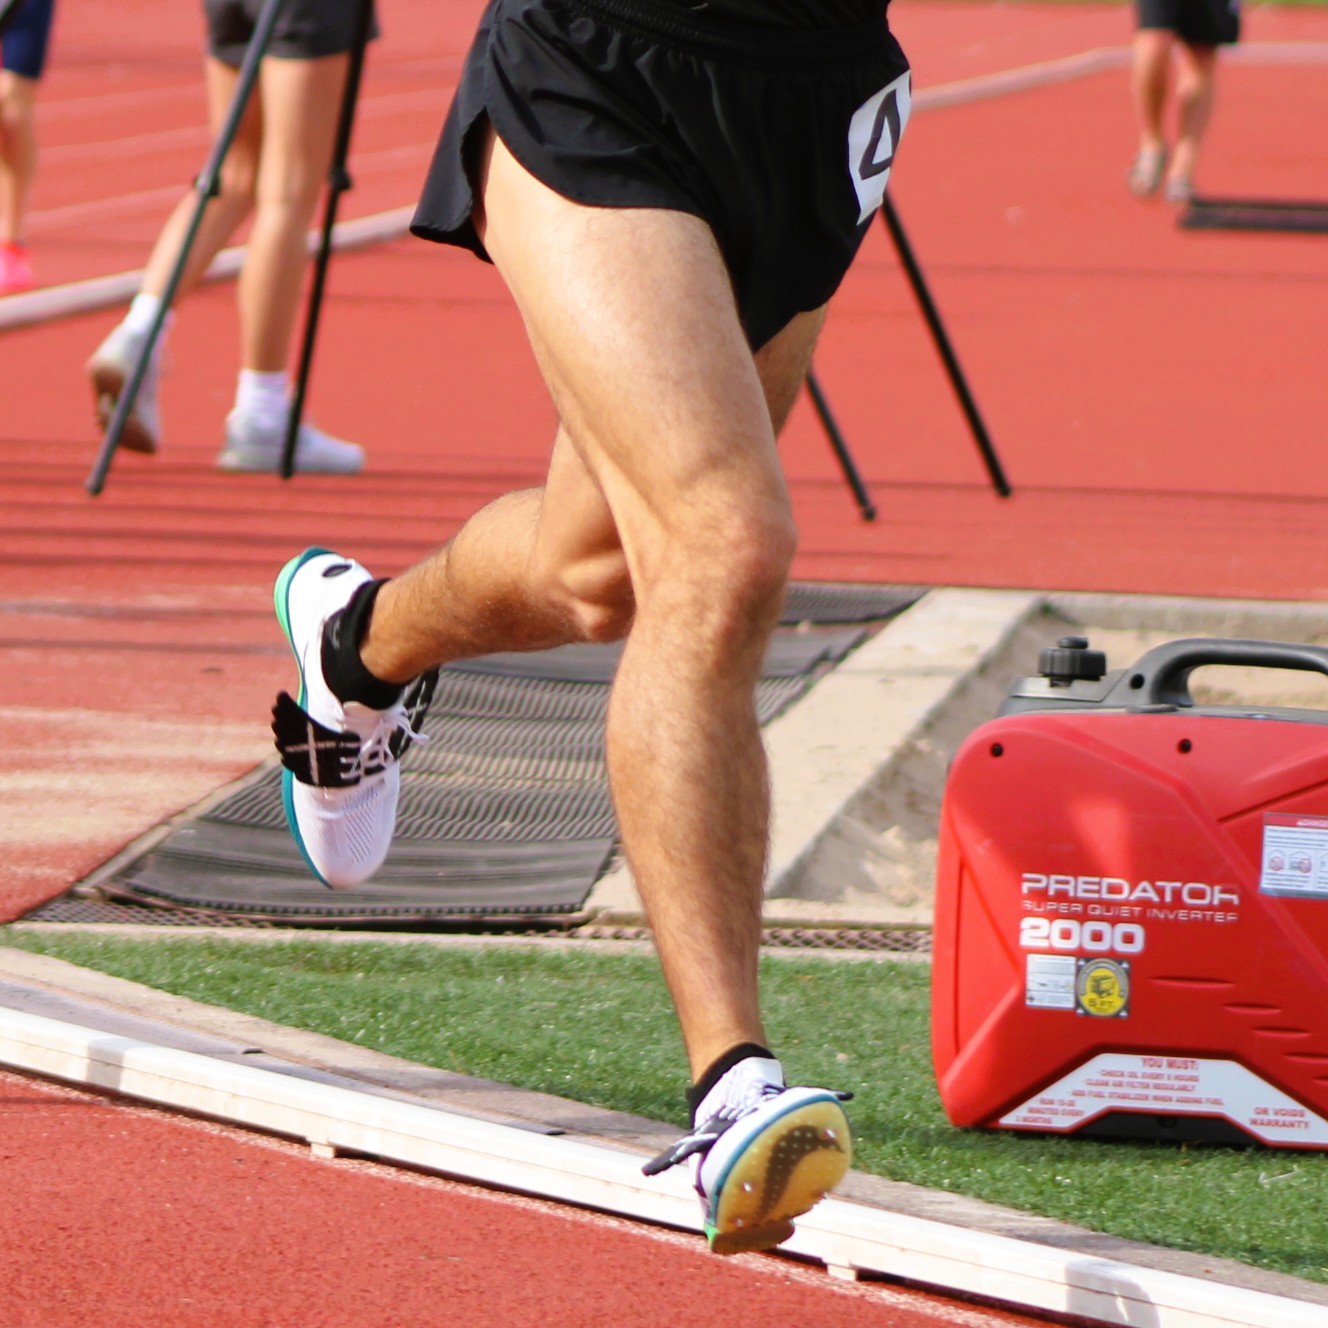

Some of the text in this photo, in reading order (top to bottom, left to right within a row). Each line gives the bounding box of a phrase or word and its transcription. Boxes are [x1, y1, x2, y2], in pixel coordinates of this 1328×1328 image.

[1022, 872, 1240, 906] PREDATOR
[1022, 900, 1239, 922] SUPER QUIET INVERTER
[1019, 916, 1145, 953] 2000
[1141, 1058, 1163, 1068] YOU
[1272, 1108, 1305, 1117] VOIDS
[1248, 1118, 1310, 1129] WARRANTY
